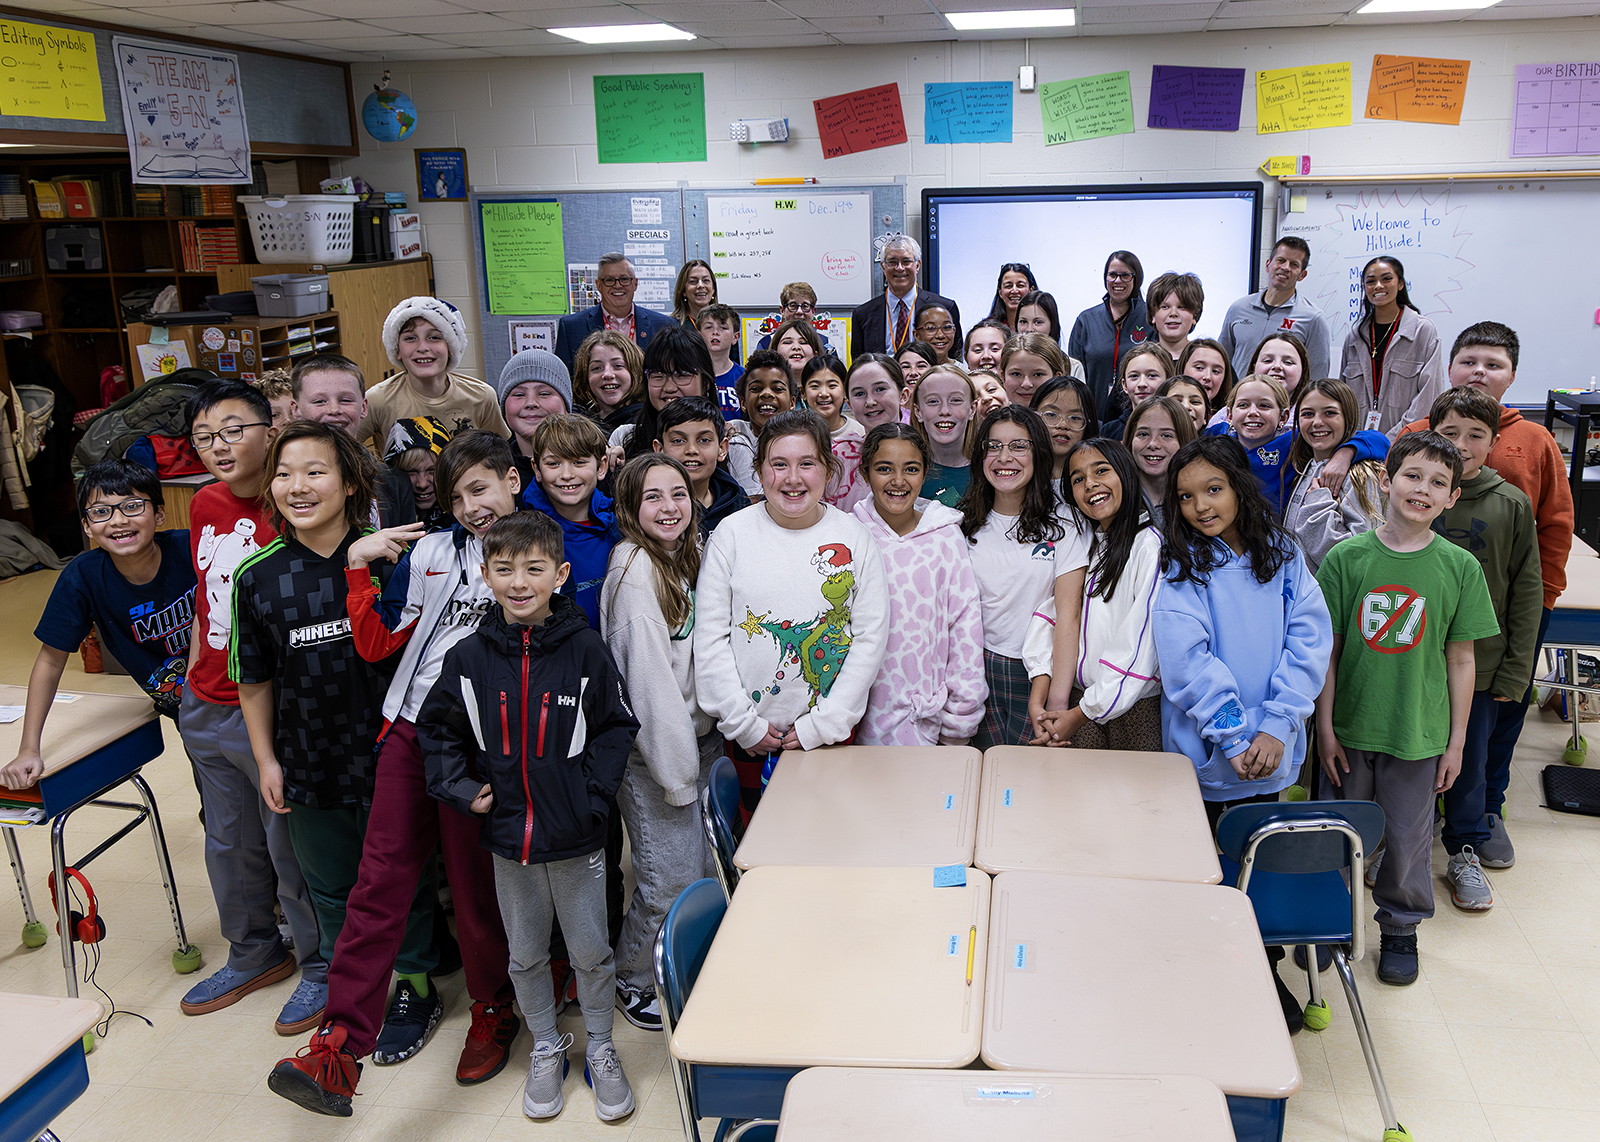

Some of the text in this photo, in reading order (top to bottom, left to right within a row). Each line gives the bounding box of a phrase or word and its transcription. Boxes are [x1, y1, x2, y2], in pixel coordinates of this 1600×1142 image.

[0, 24, 87, 56] Editing Symbols
[1376, 56, 1382, 66] 6
[147, 55, 210, 92] TEAM
[1260, 72, 1267, 80] 5
[1382, 66, 1411, 76] CONTRASTS
[1536, 67, 1552, 75] OUR
[601, 79, 696, 96] Good Public Speaking:
[927, 85, 933, 94] 2
[1043, 85, 1049, 95] 3
[1271, 83, 1286, 92] Aha
[1052, 92, 1071, 104] WORDS
[1265, 89, 1295, 105] Moment
[167, 93, 211, 130] 5-N
[816, 102, 822, 111] 1
[1369, 105, 1383, 116] CC
[1261, 122, 1280, 132] AHA
[929, 134, 939, 143] AA
[1047, 131, 1066, 143] WW
[828, 146, 843, 156] MM
[775, 200, 797, 209] H.W.
[809, 200, 853, 215] Dec. 19th
[492, 205, 555, 226] Hillside Pledge
[720, 202, 758, 224] Friday
[1352, 208, 1441, 232] Welcome to
[726, 229, 739, 237] read
[745, 228, 761, 240] great
[826, 255, 842, 266] bring
[1280, 317, 1296, 330] N
[532, 332, 546, 340] Kind
[129, 600, 156, 620] 92
[1362, 592, 1426, 645] 67
[557, 695, 576, 707] HH
